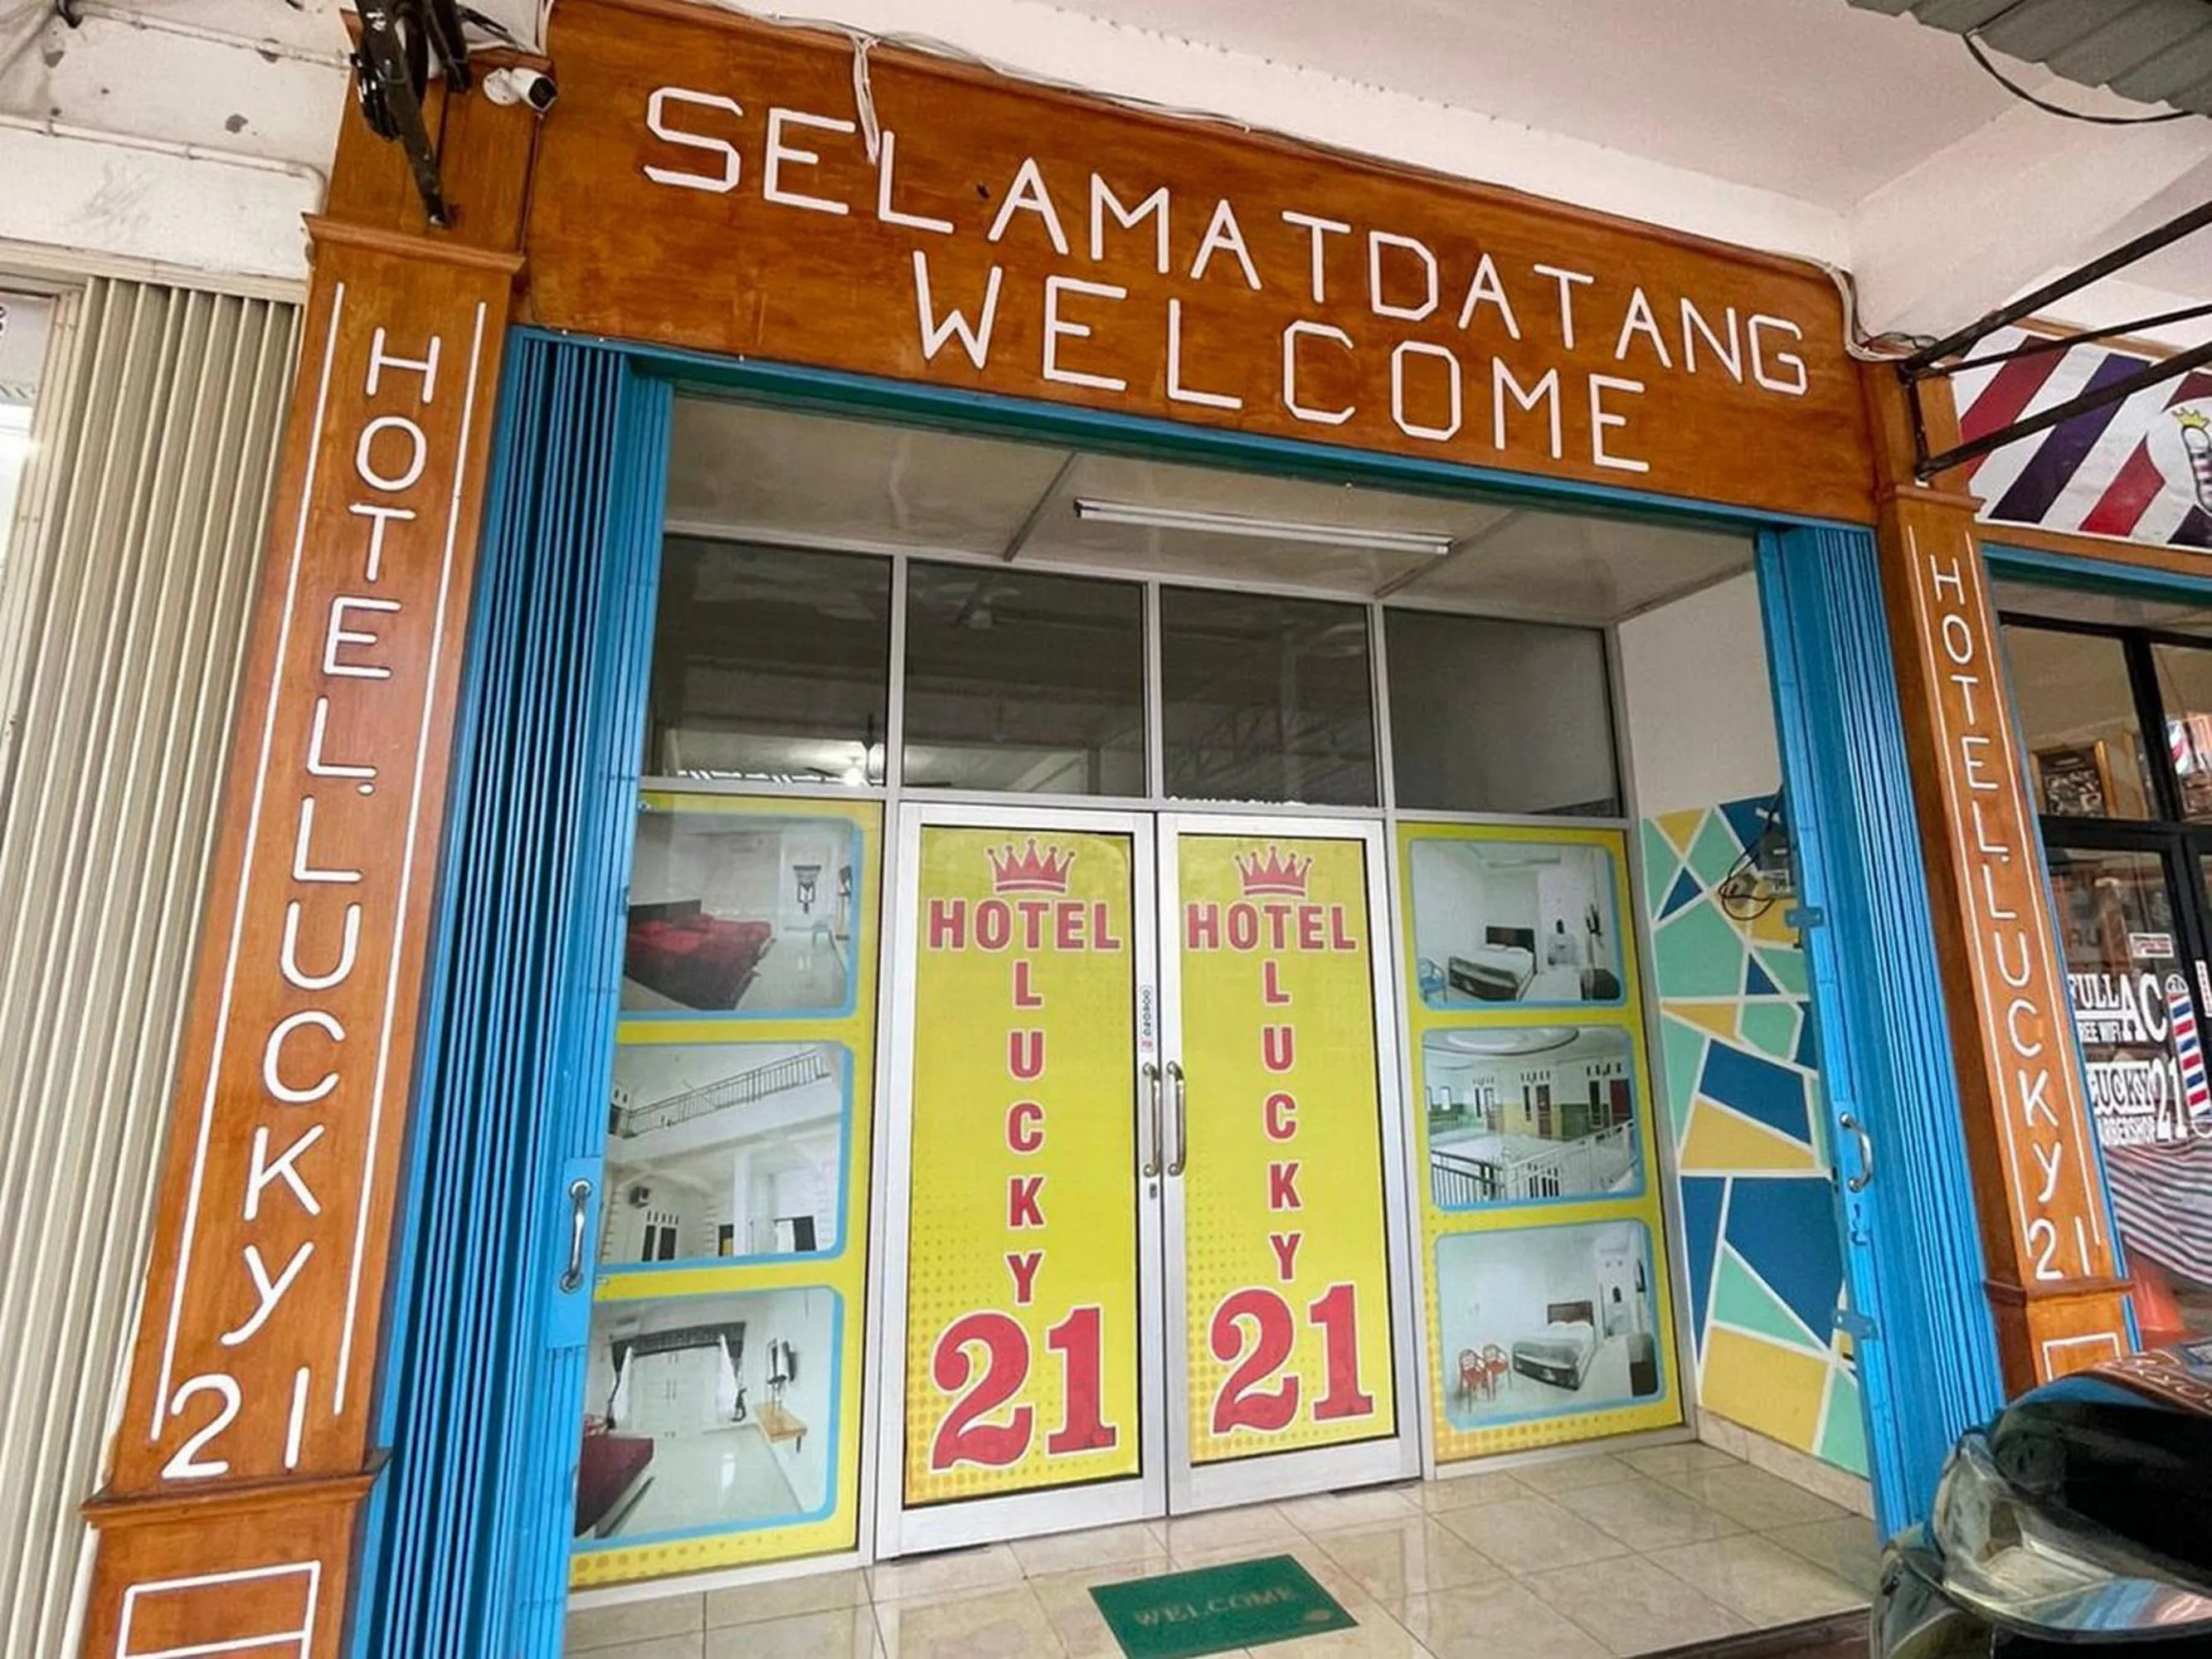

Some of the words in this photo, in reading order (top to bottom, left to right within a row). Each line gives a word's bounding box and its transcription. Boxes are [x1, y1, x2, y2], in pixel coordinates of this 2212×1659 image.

[912, 250, 1650, 472] WELCOME
[928, 899, 1121, 951] HOTEL
[1185, 903, 1357, 951] HOTEL
[1006, 960, 1046, 1304] LUCKY
[1261, 960, 1300, 1281] LUCKY
[2029, 1216, 2092, 1280] 21
[161, 1366, 309, 1479] 21
[931, 1305, 1118, 1471] 21
[1209, 1282, 1373, 1435] 21
[1134, 1587, 1293, 1626] WELCOME
